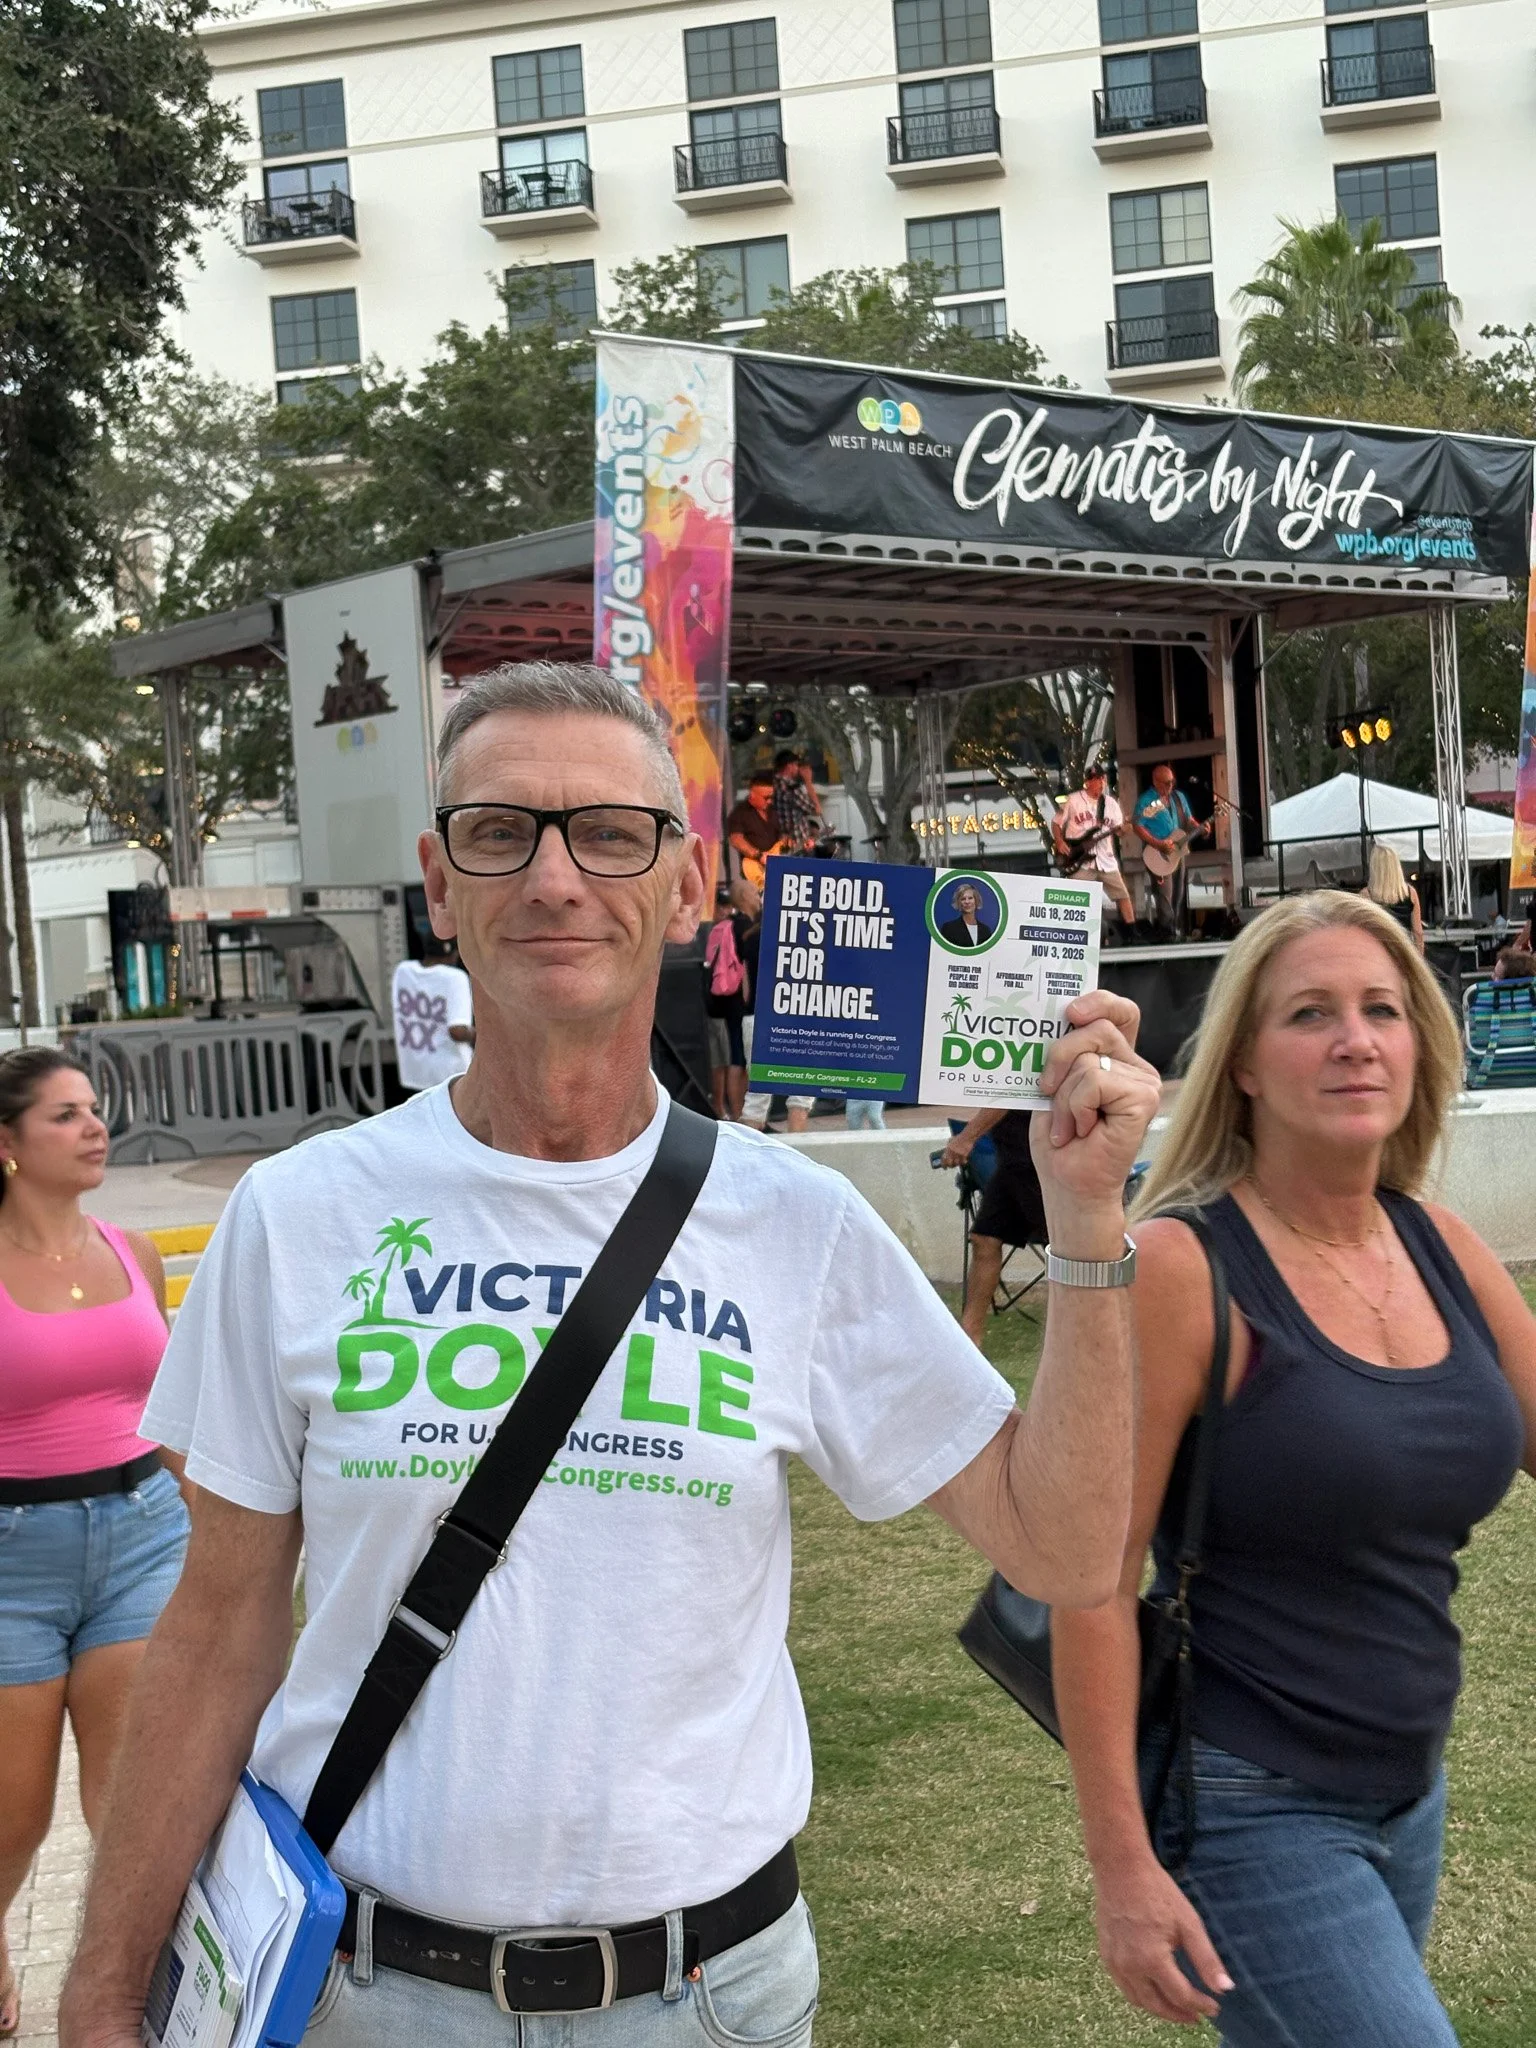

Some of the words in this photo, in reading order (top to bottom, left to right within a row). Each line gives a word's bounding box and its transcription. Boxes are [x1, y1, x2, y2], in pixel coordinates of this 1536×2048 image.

[828, 435, 867, 449] WEST
[871, 438, 904, 453] PALM
[909, 442, 952, 457] BEACH
[953, 407, 1207, 527] Clematis
[1209, 440, 1258, 558] by
[1271, 435, 1404, 550] Night
[599, 396, 651, 695] rg/events
[1335, 528, 1477, 562] wpb.org/events
[781, 873, 814, 908] BE
[819, 876, 890, 914] BOLD.
[1048, 893, 1086, 903] PRIMARY
[778, 910, 826, 945] IT'S
[832, 913, 895, 950] TIME
[1029, 906, 1047, 918] AUG
[1049, 907, 1061, 921] 18,
[1063, 909, 1086, 922] 2026
[1023, 930, 1066, 940] ELECTION
[1067, 934, 1085, 942] DAY
[1031, 945, 1049, 957] NOV
[1051, 947, 1060, 960] 3,
[1062, 948, 1085, 961] 2026
[775, 945, 825, 981] FOR
[773, 981, 879, 1021] CHANGE.
[770, 1036, 797, 1044] because
[771, 1027, 797, 1035] Victoria
[798, 1029, 818, 1037] Doyle
[865, 1033, 897, 1042] Congress
[782, 1046, 806, 1054] Federal
[940, 1036, 1044, 1073] DOYL
[767, 1070, 803, 1078] Democrat
[816, 1073, 850, 1082] Congress
[938, 1071, 966, 1082] FOR
[972, 1074, 999, 1085] U.S.
[404, 1262, 752, 1354] VICTRIA
[332, 1323, 757, 1441] DOLE
[401, 1423, 458, 1443] FOR
[469, 1425, 500, 1444] U.
[559, 1431, 684, 1460] NGRESS
[340, 1454, 734, 1507] www.DoylCongress.org
